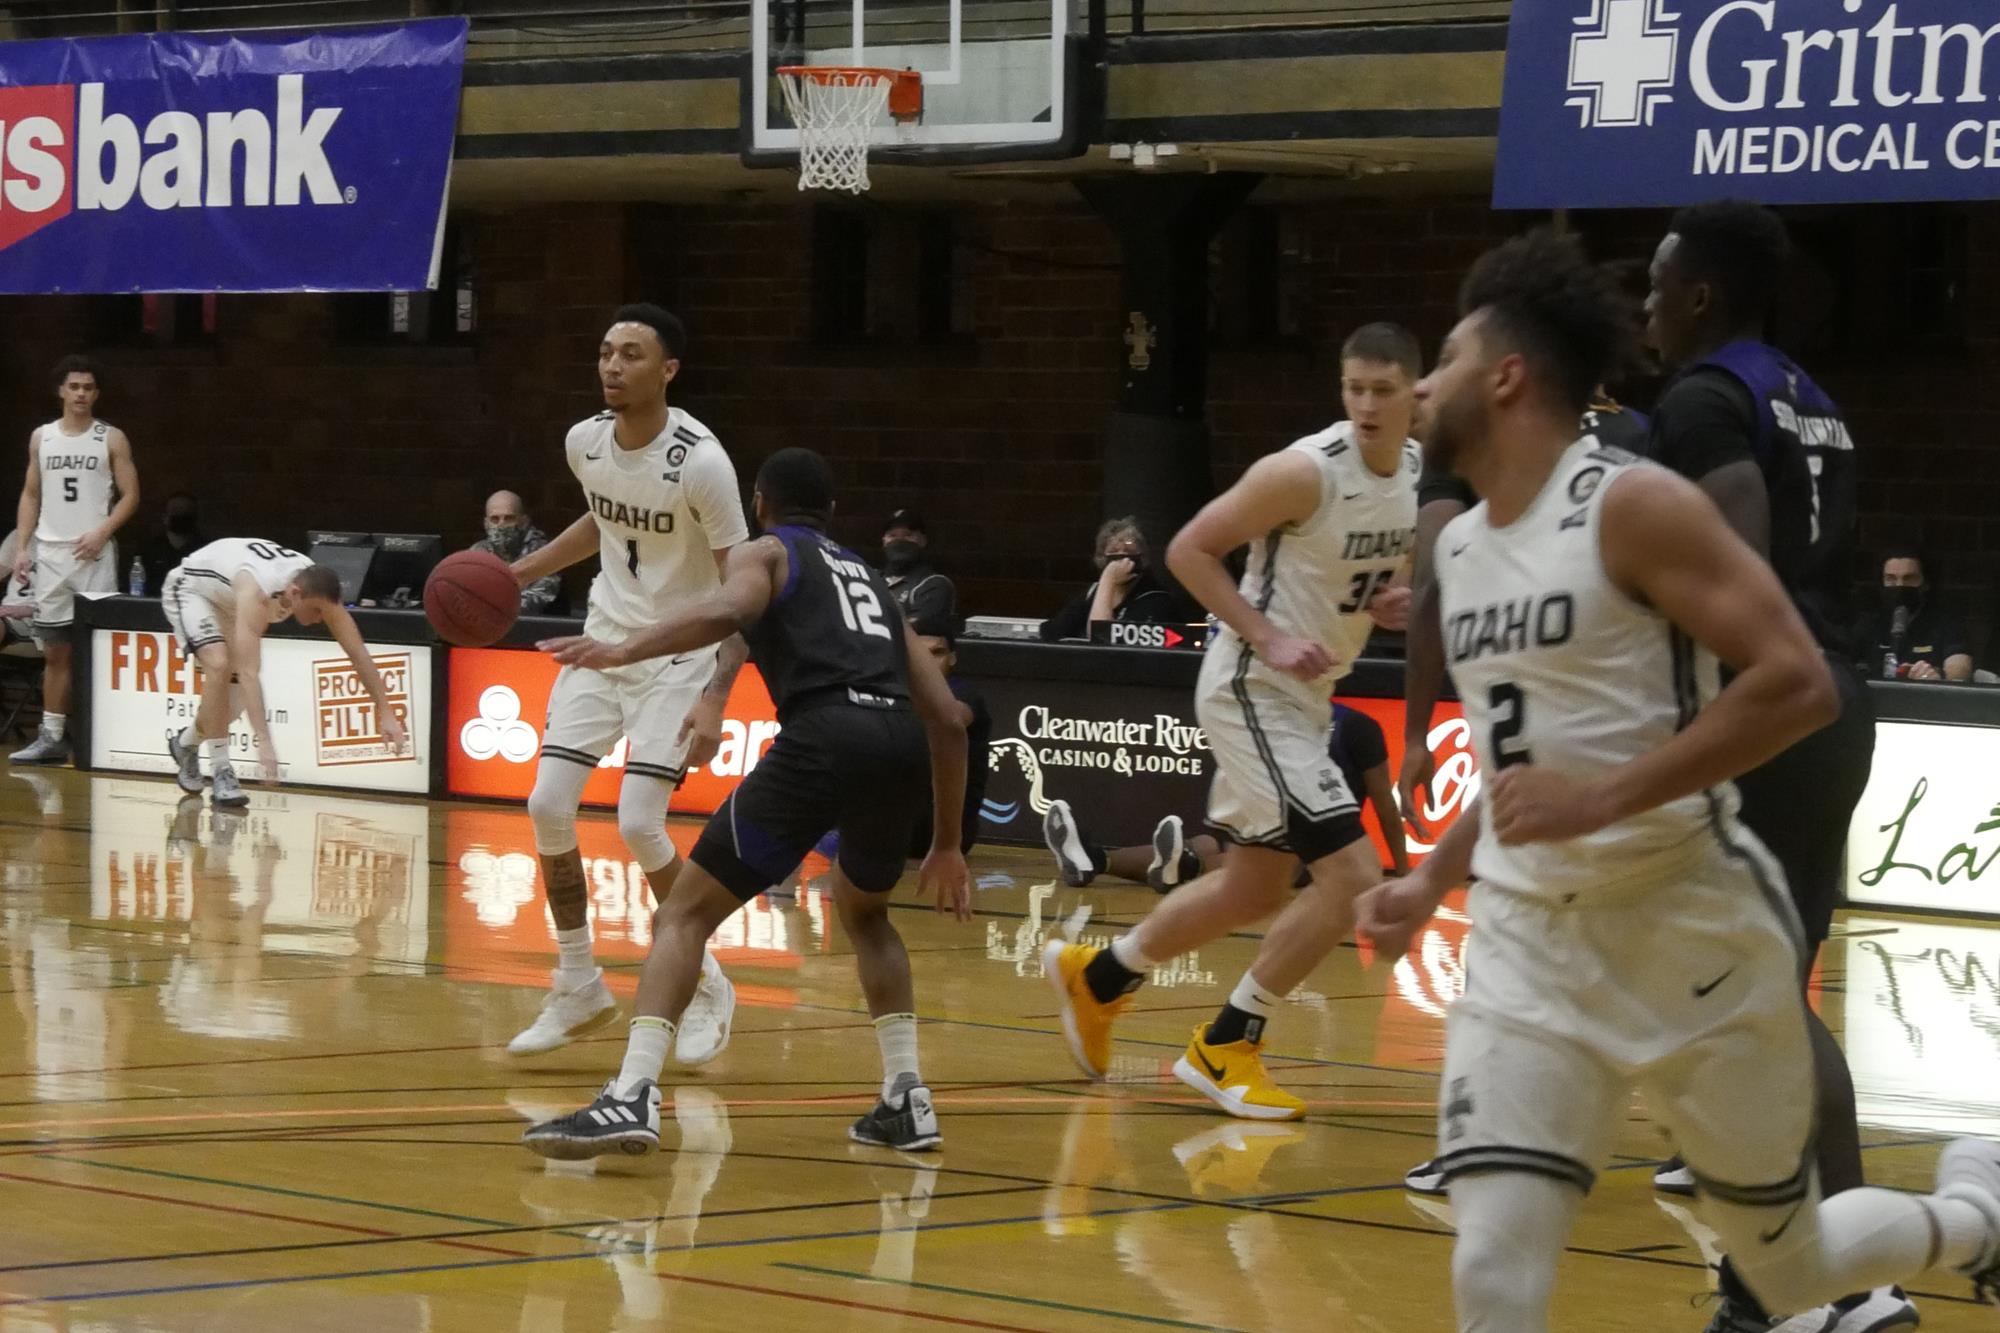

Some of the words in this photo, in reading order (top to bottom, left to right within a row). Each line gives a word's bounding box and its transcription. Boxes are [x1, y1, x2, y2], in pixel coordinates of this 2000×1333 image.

[0, 114, 65, 213] s
[77, 73, 344, 211] bank
[1692, 123, 1930, 175] MEDICAL
[46, 455, 99, 471] IDAHO
[63, 477, 79, 502] 5
[589, 491, 675, 534] IDAHO
[625, 538, 641, 580] 1
[831, 571, 892, 641] 12
[1449, 593, 1575, 663] DAHO
[1110, 623, 1166, 647] POSS
[318, 670, 406, 699] PROCT
[1018, 705, 1154, 746] Clearwater
[1154, 714, 1214, 755] Rive
[1488, 681, 1536, 772] 2
